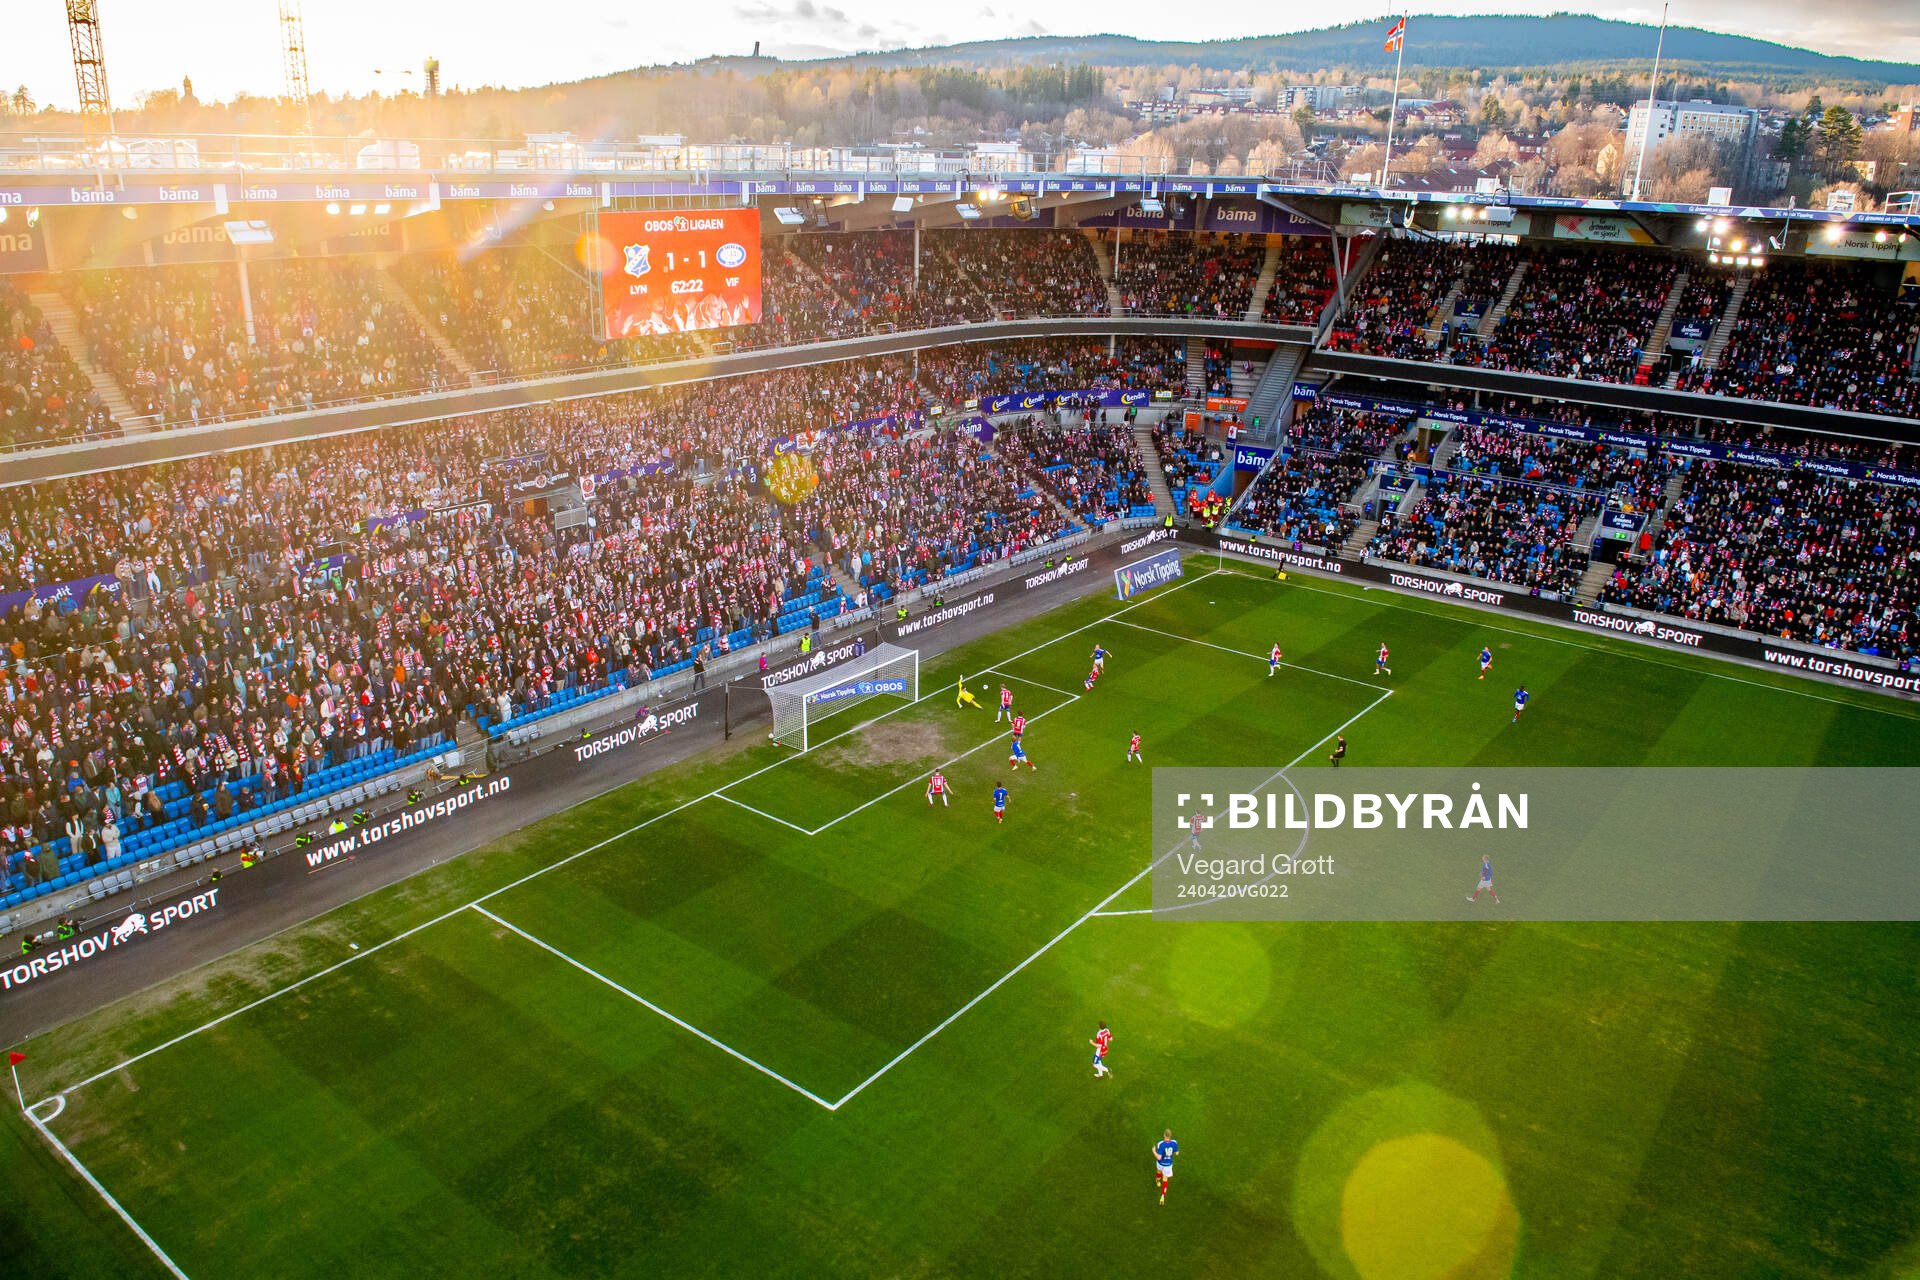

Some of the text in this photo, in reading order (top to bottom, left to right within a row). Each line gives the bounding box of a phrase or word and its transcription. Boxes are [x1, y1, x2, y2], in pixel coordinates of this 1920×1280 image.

[159, 187, 199, 200] bama
[316, 185, 350, 199] bama
[385, 185, 417, 198] bama
[450, 185, 480, 197] bama
[510, 184, 538, 196] bama
[566, 184, 592, 196] bama
[755, 182, 776, 193] bama
[796, 182, 815, 192] bama
[833, 182, 852, 192] bama
[0, 192, 22, 203] ma
[71, 188, 114, 203] bama
[1216, 206, 1257, 222] bama
[644, 218, 724, 232] OBOS LIGAEN
[1844, 240, 1870, 249] Norsk
[666, 252, 674, 271] 1
[698, 250, 706, 269] 1
[671, 279, 703, 294] 62:22
[725, 277, 740, 287] VIF
[630, 285, 648, 295] LYN
[1126, 392, 1146, 401] Bendit
[1293, 385, 1316, 397] bam
[1547, 426, 1585, 438] Norsk Tipping
[1608, 434, 1647, 446] Norsk Tipping
[1671, 443, 1712, 455] Norsk Tipping
[1237, 450, 1270, 467] bam
[1824, 463, 1849, 475] Tipping
[1876, 472, 1896, 481] Norsk
[1121, 535, 1148, 555] TORSHOV
[1025, 558, 1089, 590] TORSHOV SPORT
[1133, 559, 1181, 588] Norsk Tipping
[1390, 573, 1504, 606] TORSHOV SPORT
[897, 592, 995, 637] www.torshovsport.no
[1573, 610, 1702, 647] TORSHOV SPORT
[761, 659, 811, 689] TORSHOV
[1764, 650, 1920, 691] www.torshovsport
[820, 686, 856, 701] Norsk Tipping
[875, 682, 903, 692] OBOS
[574, 702, 699, 761] TORSHOV SPORT
[306, 776, 511, 867] www.torshovsport.no
[0, 888, 219, 990] TORSHOV SPORT
